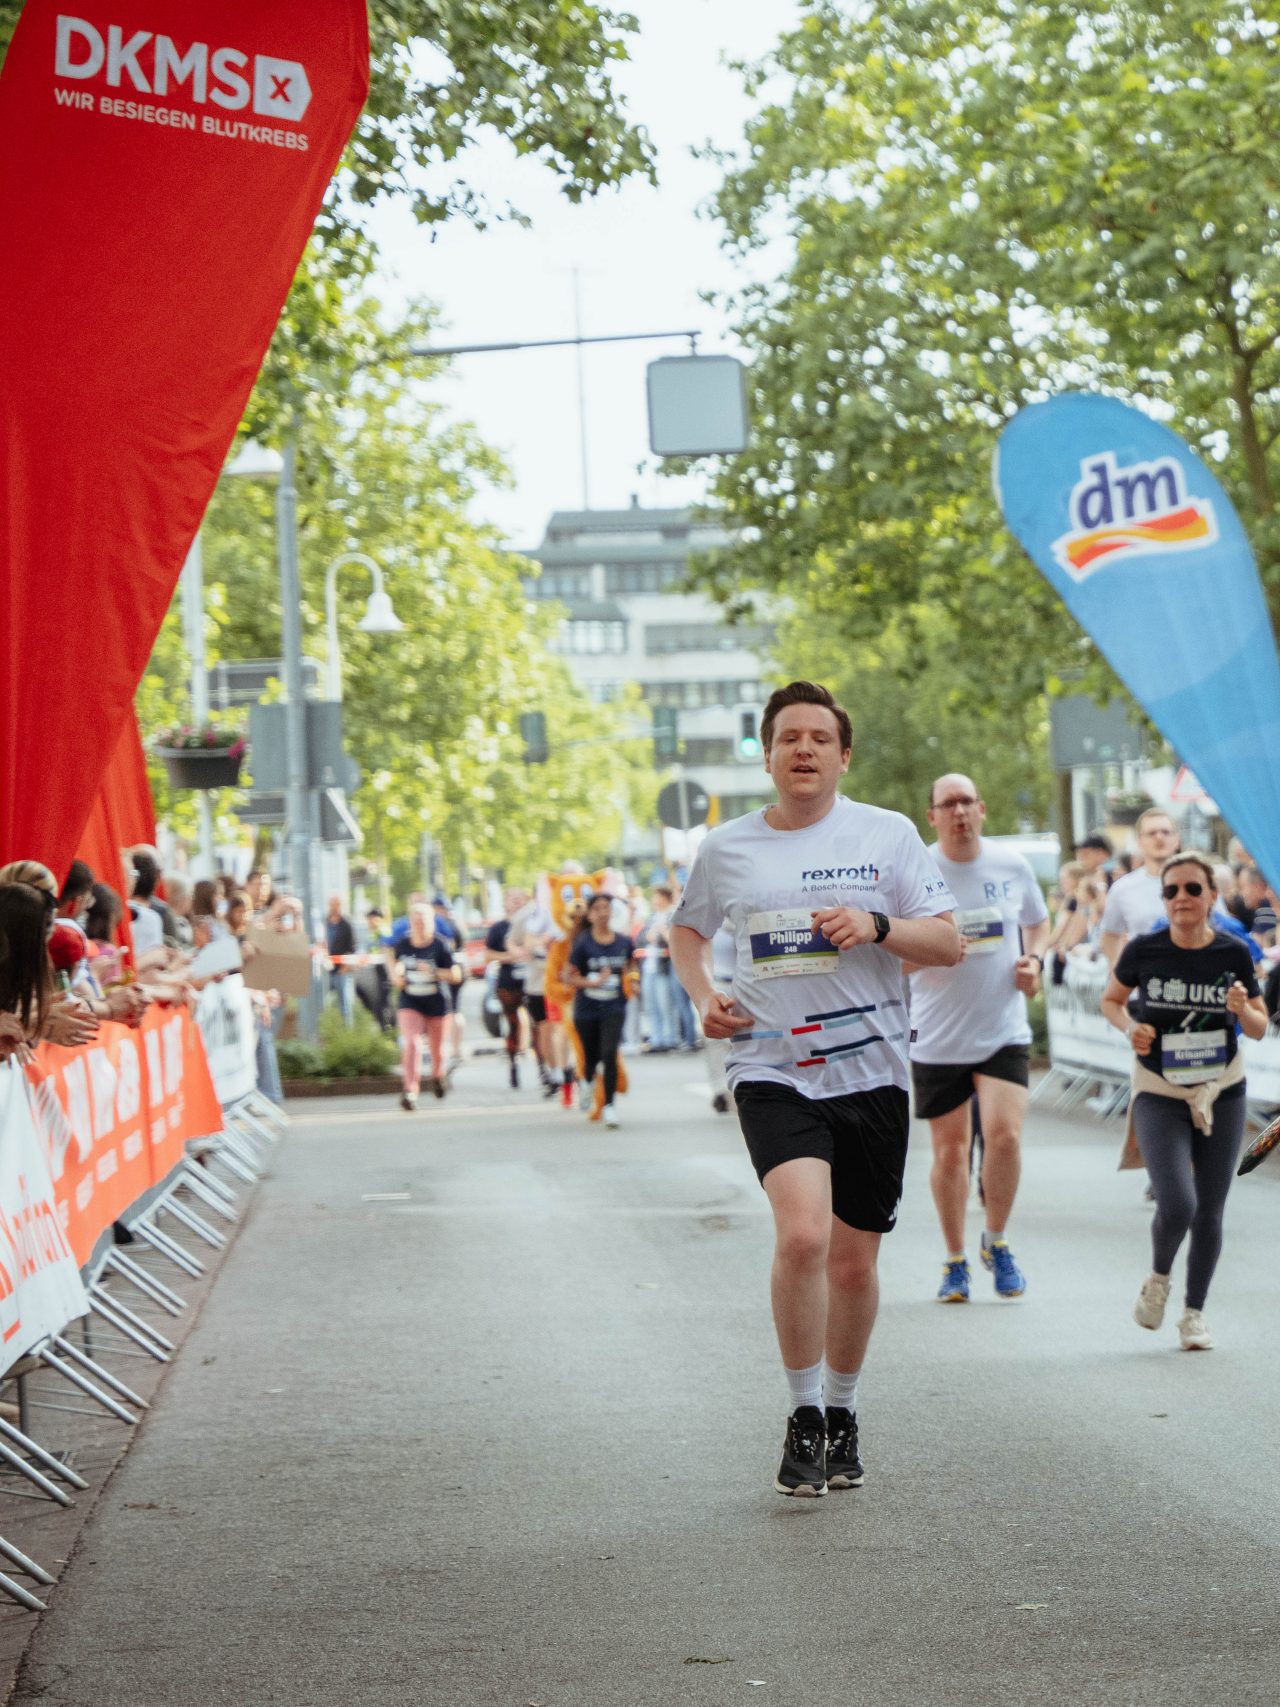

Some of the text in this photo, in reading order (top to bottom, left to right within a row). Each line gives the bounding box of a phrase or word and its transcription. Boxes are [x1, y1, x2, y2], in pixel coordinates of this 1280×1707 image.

[55, 15, 250, 110] DKMS
[54, 88, 309, 151] WIR BESIEGEN BLUTKREBS
[1077, 461, 1179, 530] dm
[802, 863, 879, 881] rexroth
[802, 883, 877, 894] A Bosch Company
[769, 930, 813, 945] Philipp
[1189, 984, 1227, 1005] UKS
